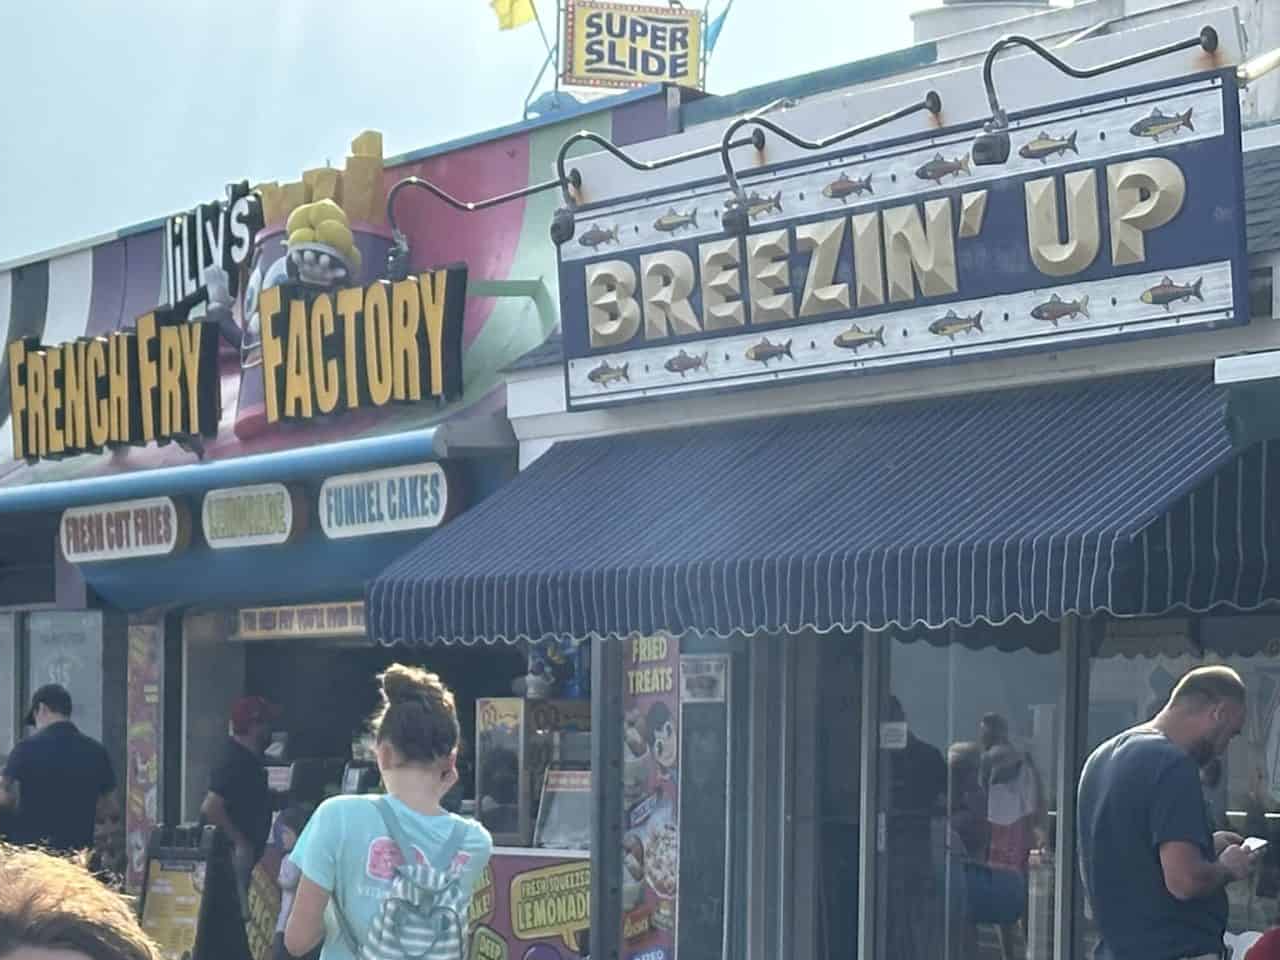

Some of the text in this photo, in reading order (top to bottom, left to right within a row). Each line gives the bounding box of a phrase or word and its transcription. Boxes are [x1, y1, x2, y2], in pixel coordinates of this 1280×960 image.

[585, 11, 689, 51] SUPER
[585, 39, 689, 79] SLIDE
[585, 156, 1187, 349] BREEZIN' UP
[258, 270, 448, 423] FACTORY
[9, 311, 202, 461] FRENCH FRY
[325, 471, 441, 529] FUNNEL CAKES
[65, 510, 104, 556] FRESH
[133, 504, 171, 547] FRIES
[632, 636, 668, 663] FRIED
[627, 667, 673, 693] TREATS
